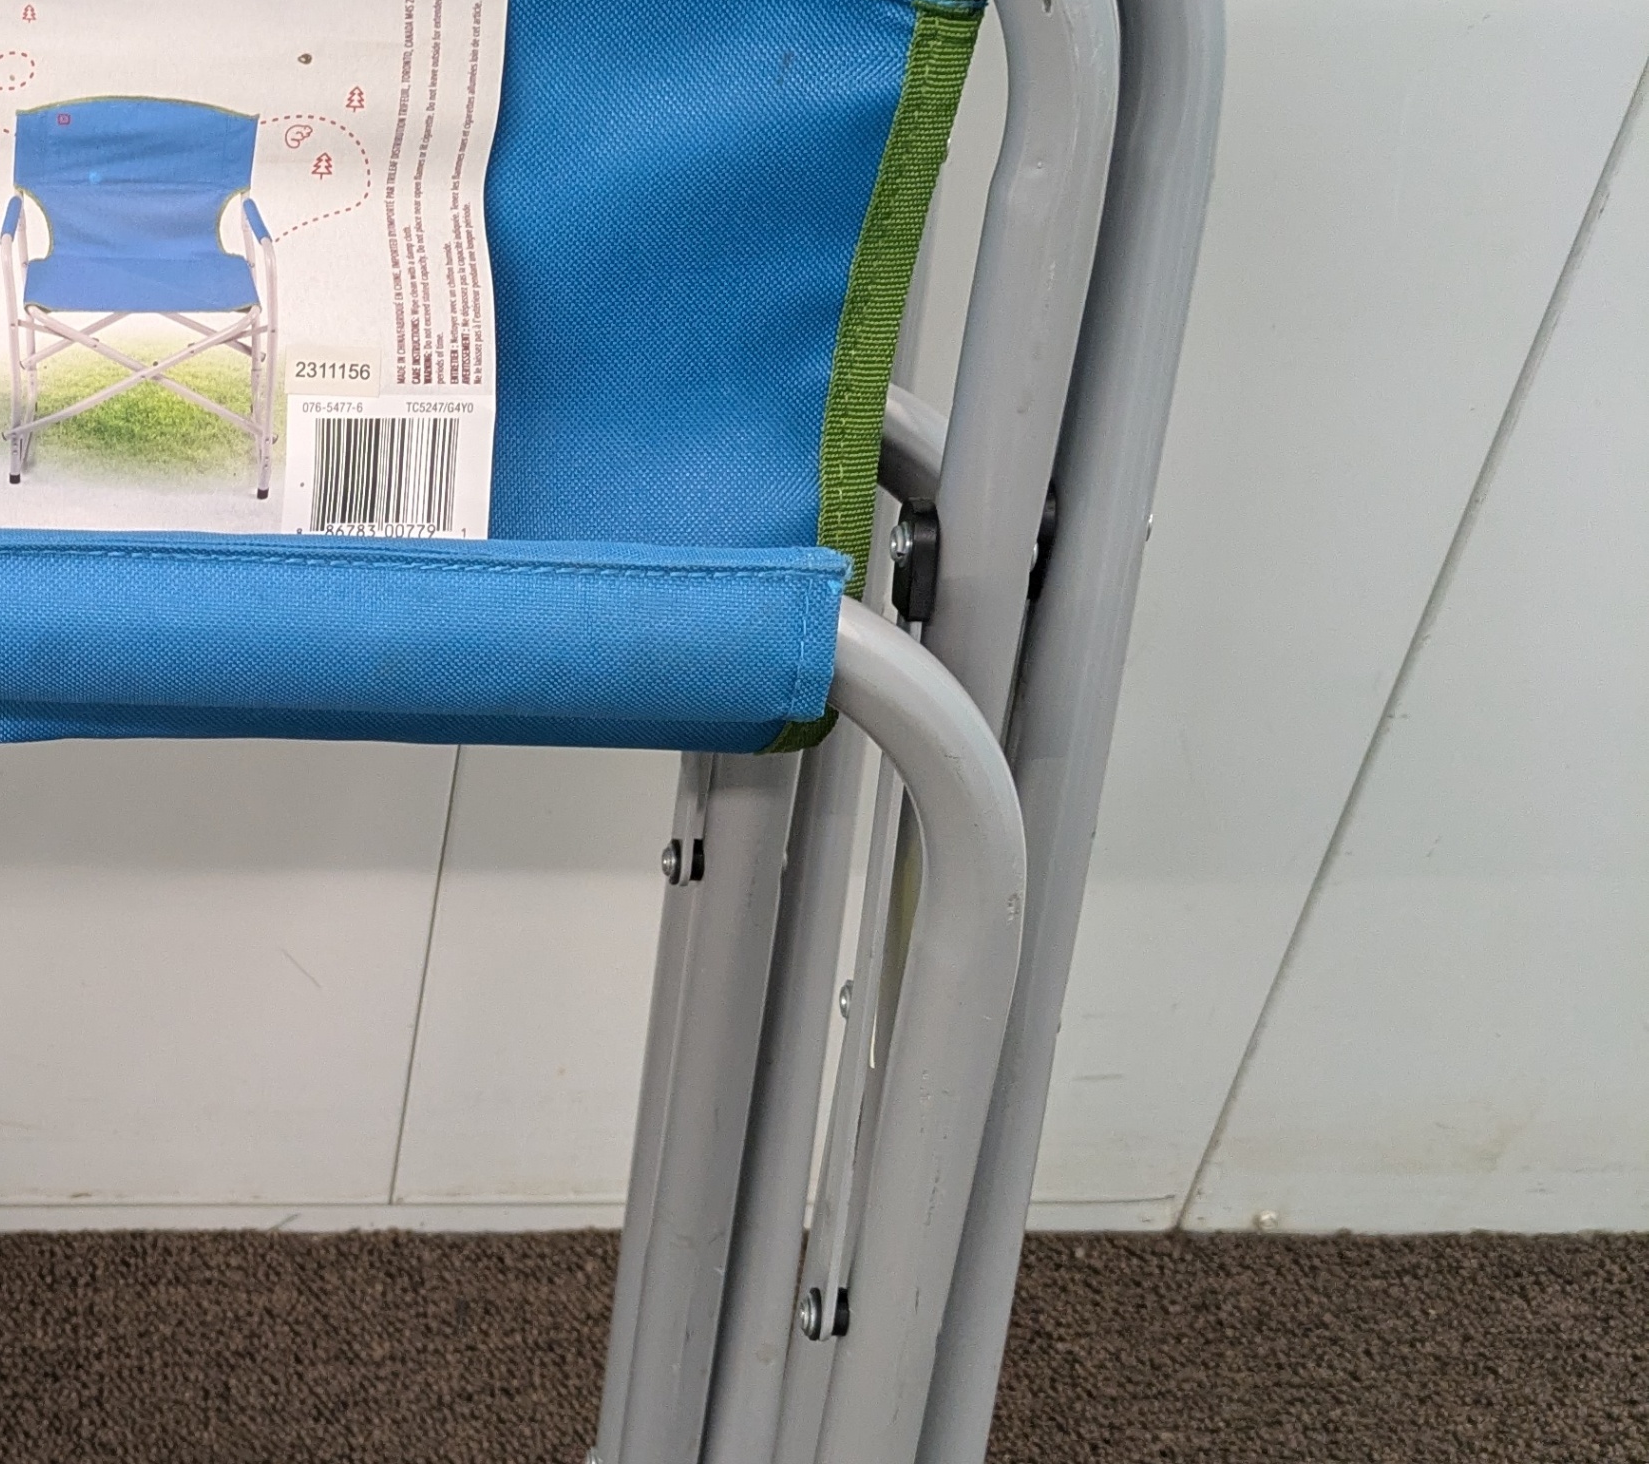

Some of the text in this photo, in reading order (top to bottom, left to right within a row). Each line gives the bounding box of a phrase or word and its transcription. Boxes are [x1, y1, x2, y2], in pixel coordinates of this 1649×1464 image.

[473, 1, 482, 25] article.
[404, 22, 413, 47] CANADA
[472, 26, 480, 37] cet
[471, 39, 479, 47] de
[432, 42, 440, 67] outside
[470, 50, 478, 62] loin
[429, 69, 438, 87] leave
[426, 102, 435, 111] Do
[463, 97, 475, 129] cigarettes
[391, 118, 406, 159] DISTRIBUTION
[414, 160, 425, 180] flames
[452, 153, 464, 179] flammes
[386, 187, 394, 198] PAR
[414, 182, 422, 198] open
[451, 181, 459, 190] les
[450, 192, 459, 210] Tenez
[414, 216, 425, 232] place
[462, 203, 472, 228] période.
[403, 225, 411, 241] cloth.
[416, 234, 424, 243] not
[466, 229, 475, 249] longue
[389, 239, 400, 268] IMPORTED
[406, 243, 414, 259] damp
[417, 245, 425, 253] Do
[456, 242, 465, 266] capacité
[408, 267, 416, 279] with
[446, 267, 455, 288] chiffon
[459, 275, 468, 285] pas
[469, 263, 481, 288] pendant
[410, 281, 418, 298] clean
[421, 282, 430, 302] stated
[411, 300, 420, 315] Wipe
[422, 304, 430, 326] exceed
[449, 300, 457, 314] avec
[450, 316, 459, 343] Nettoyer
[461, 319, 469, 327] Ne
[424, 341, 431, 349] Do
[435, 332, 443, 349] time.
[474, 331, 483, 342] pas
[474, 344, 482, 366] laissez
[295, 362, 370, 380] 2311156
[397, 366, 405, 384] MADE
[412, 368, 420, 384] CARE
[424, 351, 432, 384] WARNING:
[436, 359, 445, 384] periods
[474, 375, 482, 384] Ne
[303, 403, 363, 413] 076-5477-6
[325, 525, 375, 536] 86783
[385, 525, 435, 538] 00779
